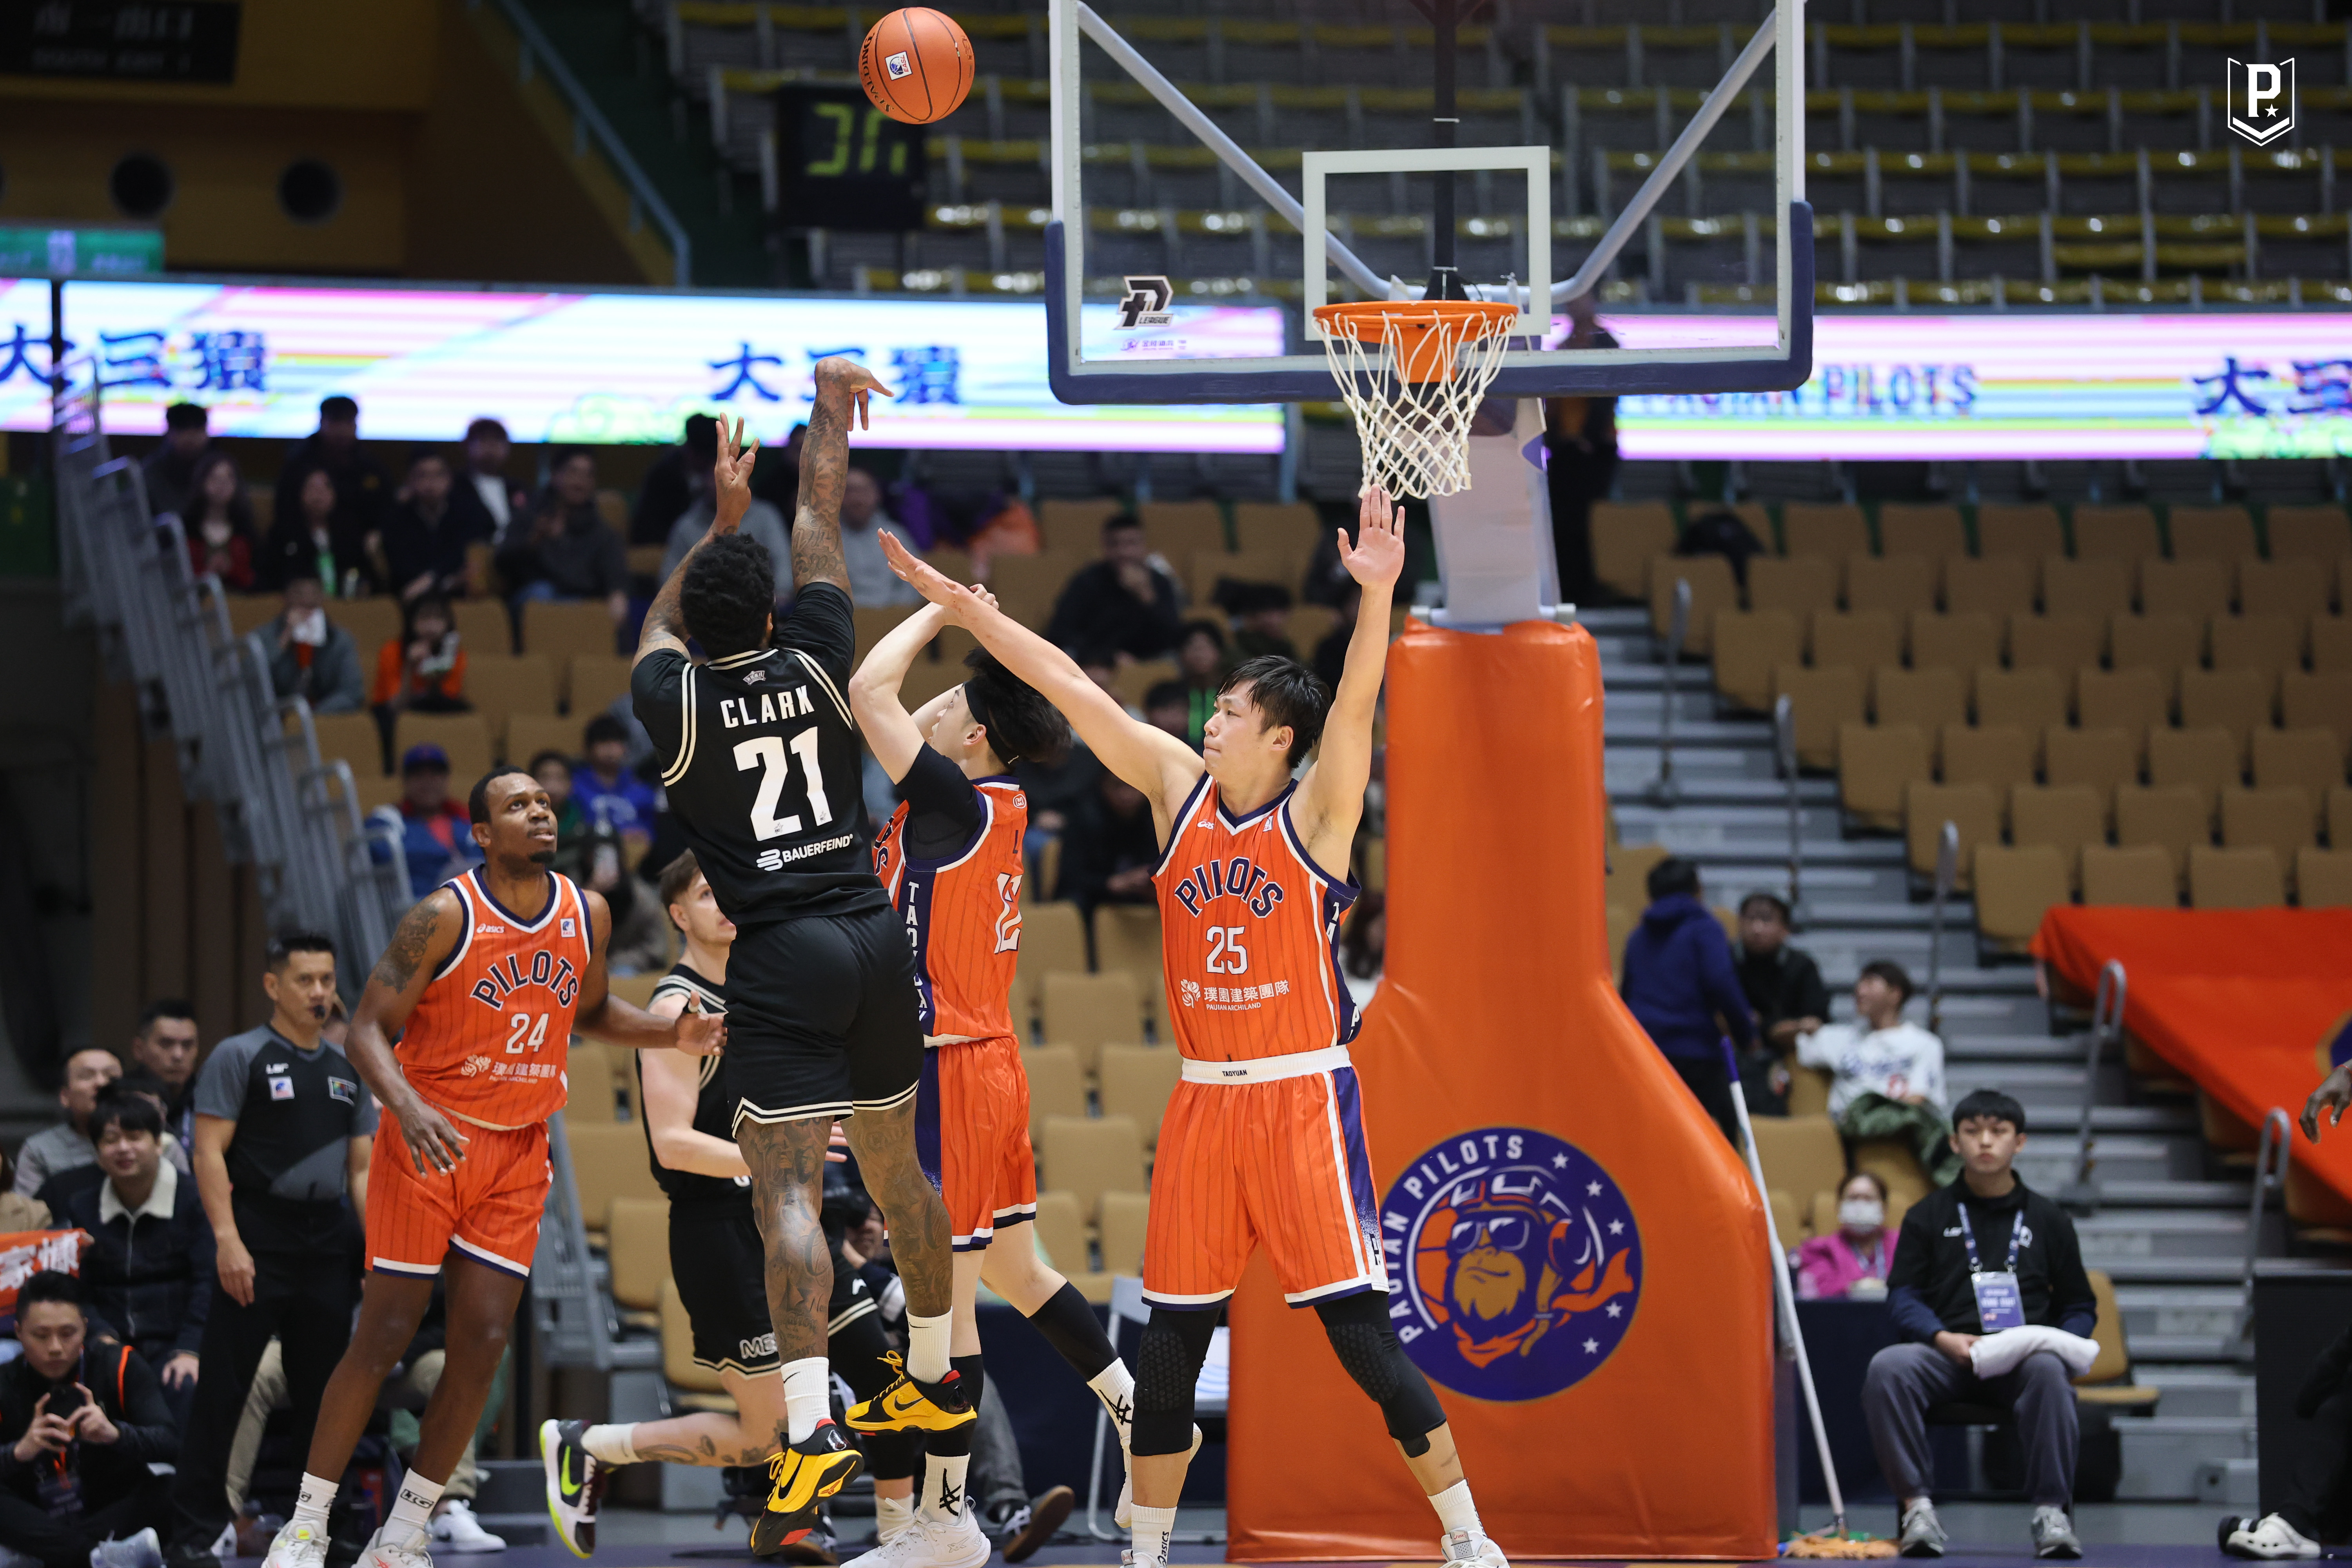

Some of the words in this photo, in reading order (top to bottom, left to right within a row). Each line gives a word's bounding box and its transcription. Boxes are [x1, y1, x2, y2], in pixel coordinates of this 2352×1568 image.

[901, 54, 909, 73] EASL
[1825, 363, 1977, 408] PILOTS
[720, 685, 815, 728] CLARK
[733, 726, 833, 842] 21
[1175, 856, 1284, 918] PILOTS
[1206, 925, 1249, 975] 25
[470, 949, 578, 1011] PILOTS
[1203, 980, 1290, 1003] 璞園建築團隊
[1227, 1002, 1261, 1011] ARCHILAND
[505, 1013, 550, 1054] 24
[1403, 1134, 1524, 1201] PILOTS
[1383, 1210, 1425, 1345] PAUIAN
[1161, 1531, 1169, 1557] asics
